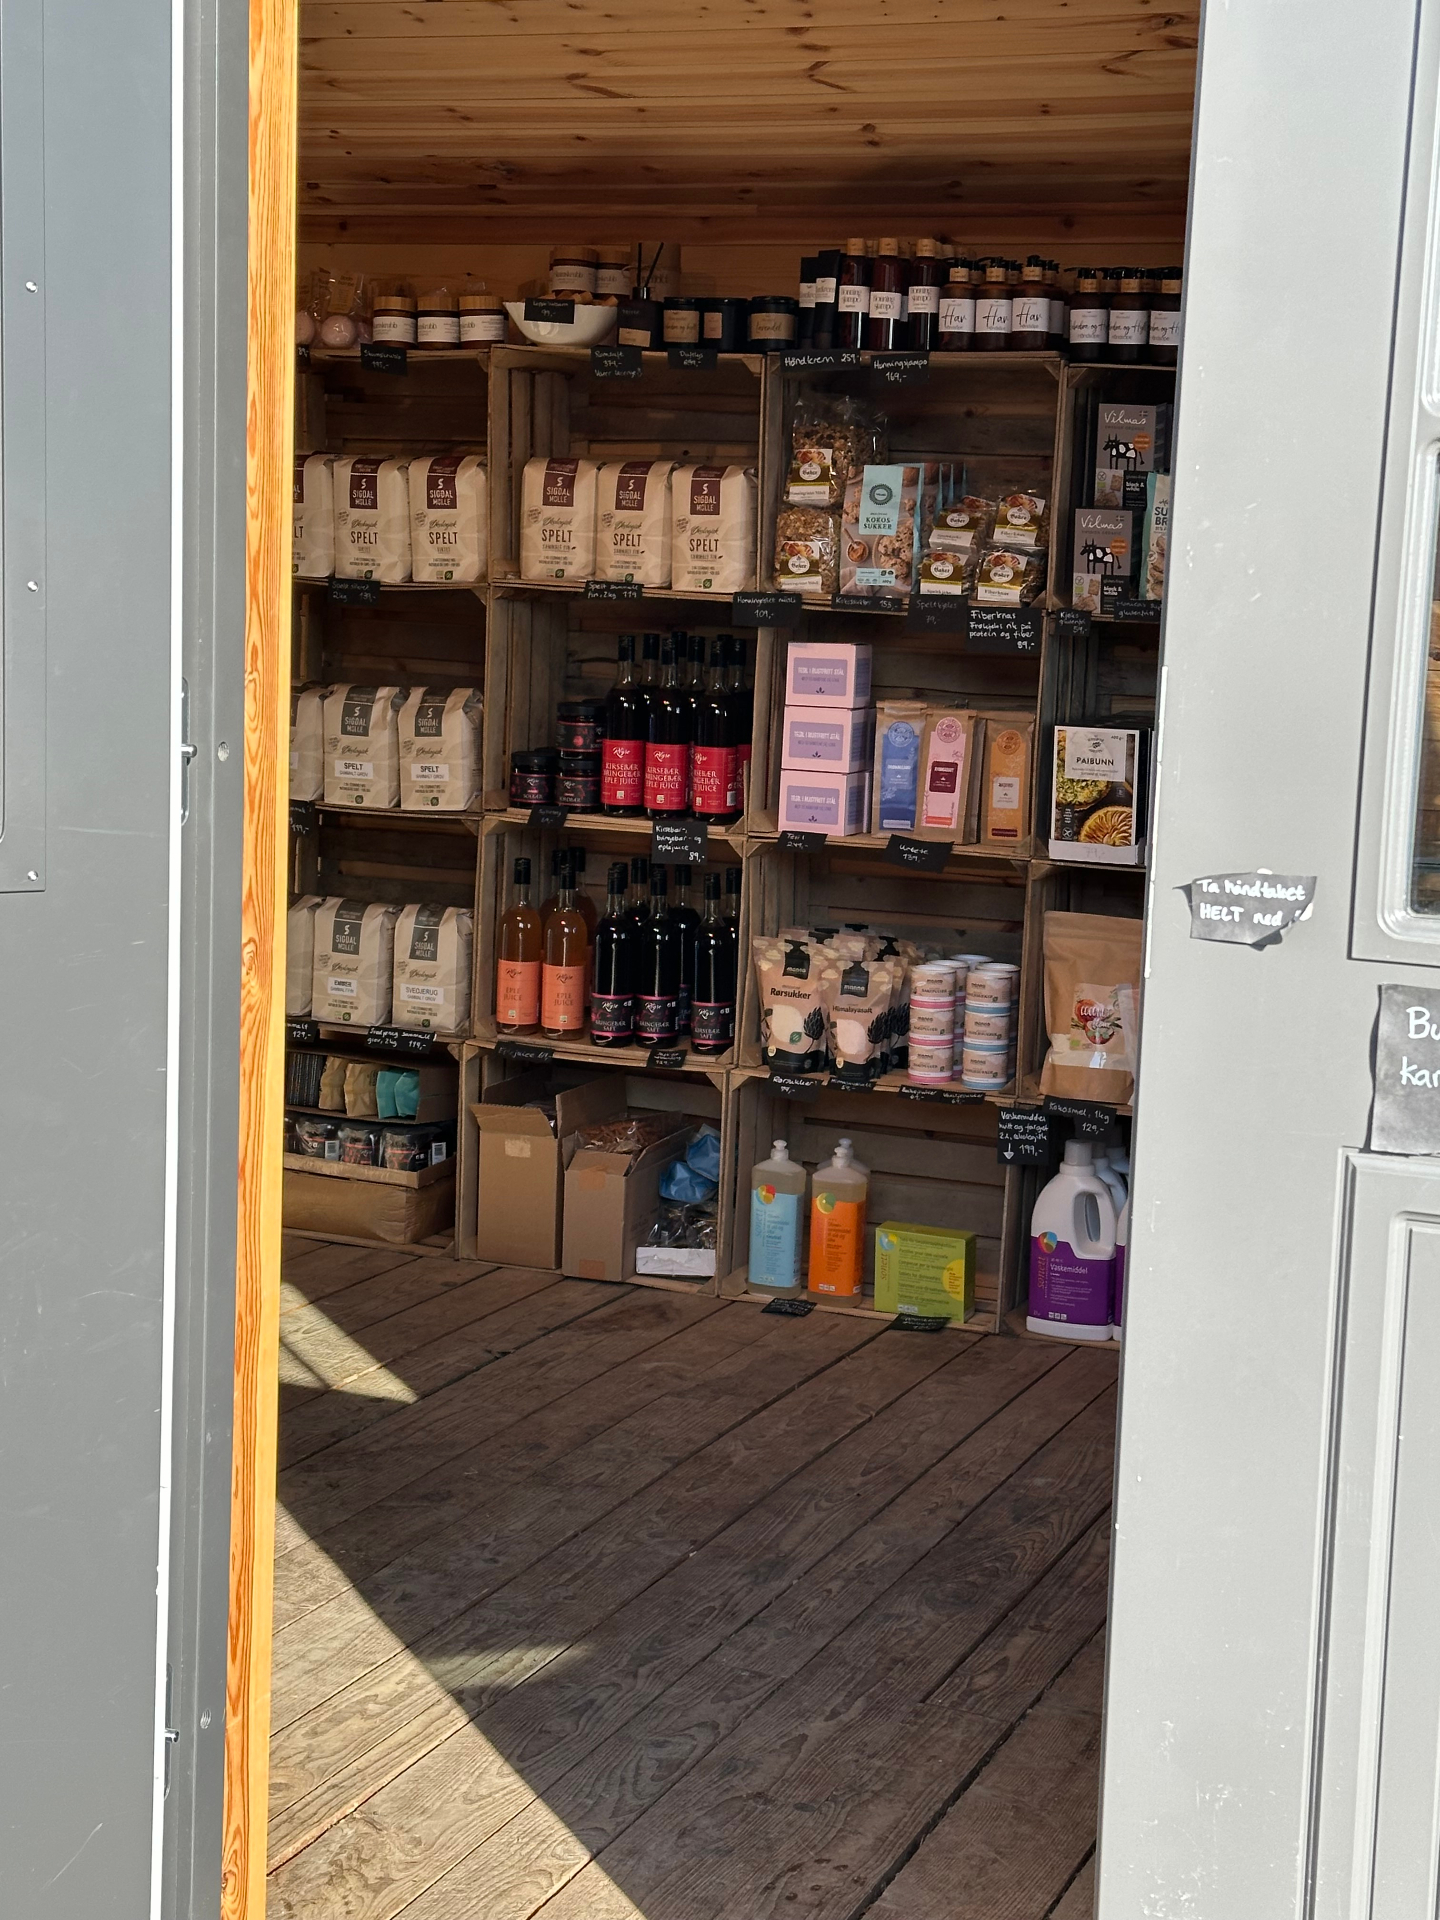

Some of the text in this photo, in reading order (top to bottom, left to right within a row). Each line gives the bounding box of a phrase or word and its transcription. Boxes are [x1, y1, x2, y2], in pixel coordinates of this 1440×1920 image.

[1104, 409, 1147, 425] Vilmas
[1081, 514, 1123, 530] Vilmas
[350, 530, 379, 545] SPELT
[429, 531, 458, 545] SPELT
[541, 528, 573, 543] SPELT
[613, 533, 642, 547] SPELT
[689, 538, 719, 552] SPELT
[344, 762, 364, 771] SPELT
[1076, 756, 1114, 766] PAIBUNN
[420, 765, 439, 773] SPELT
[694, 769, 717, 778] RSEBÆR
[619, 777, 639, 785] JUICE
[659, 781, 680, 790] JUICE
[1196, 878, 1220, 893] Ta
[1199, 902, 1245, 923] HELT
[770, 987, 812, 1000] Rørsukker
[554, 998, 574, 1006] JUICE
[1050, 1263, 1088, 1275] Vaskemiddel
